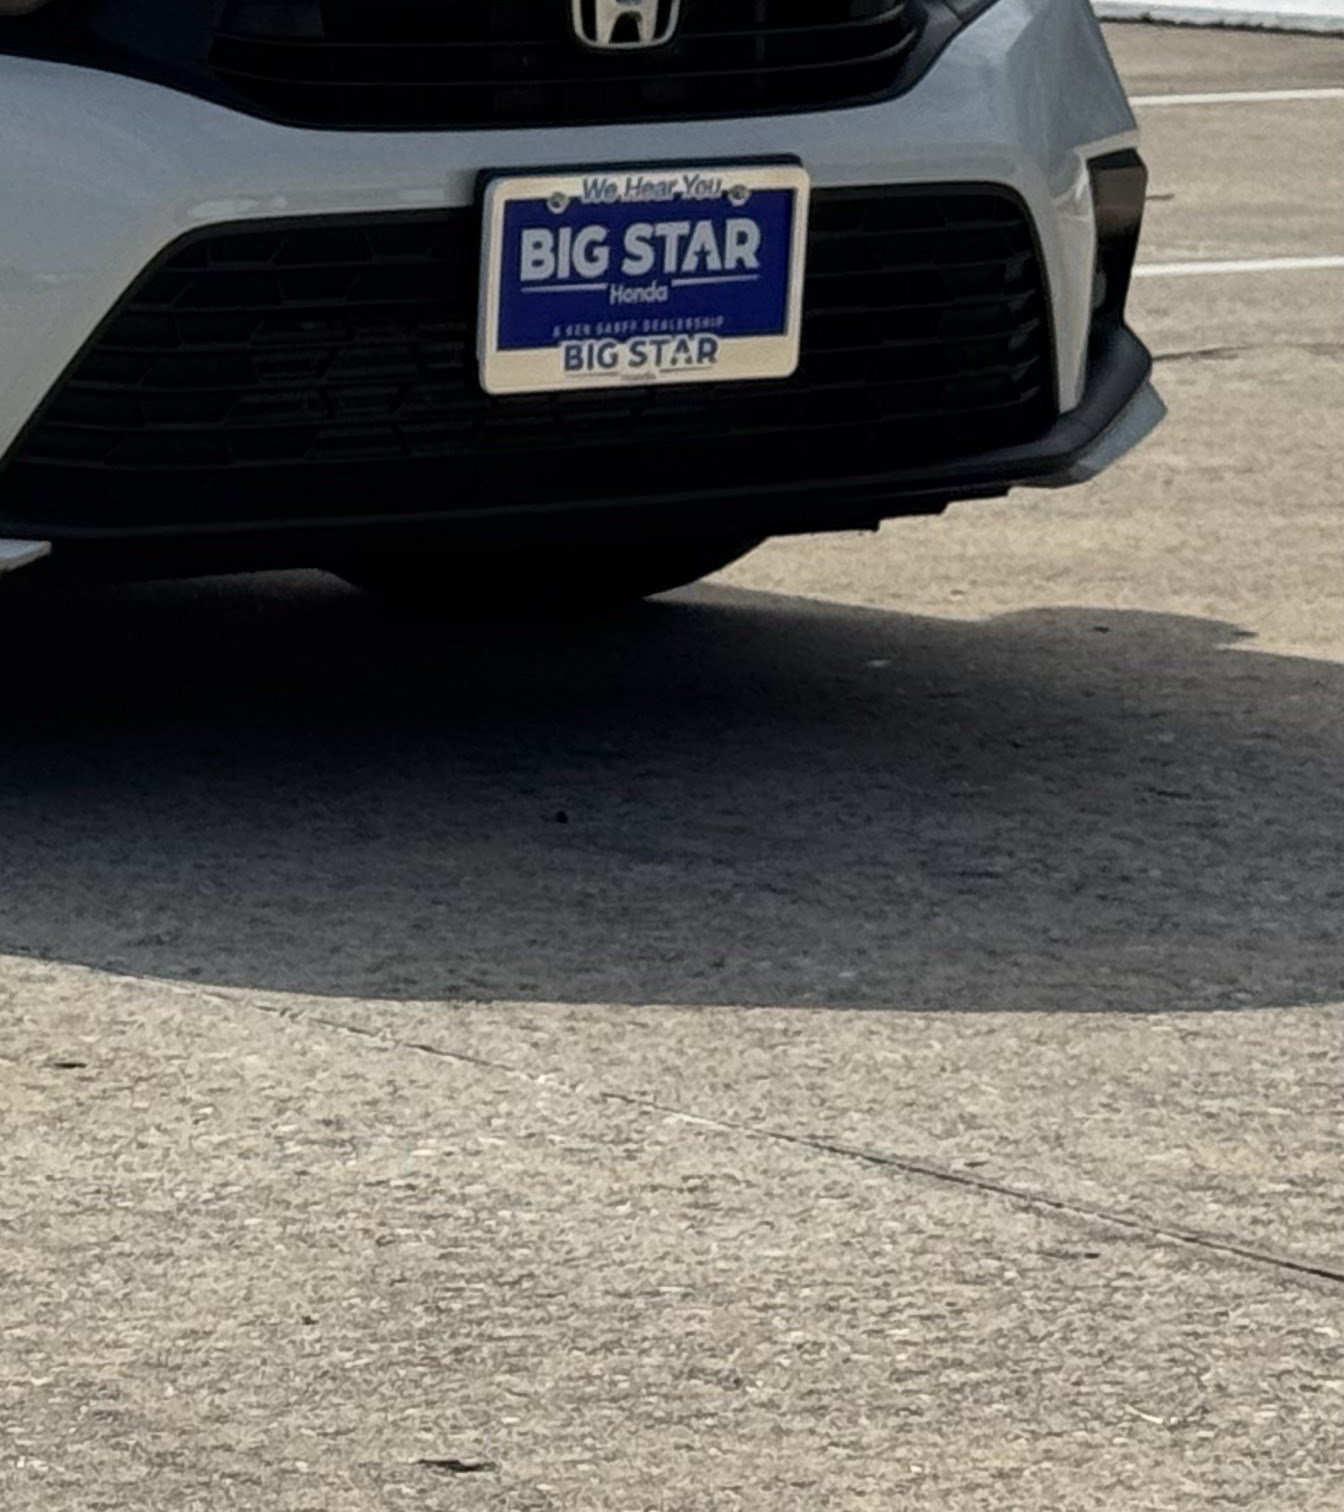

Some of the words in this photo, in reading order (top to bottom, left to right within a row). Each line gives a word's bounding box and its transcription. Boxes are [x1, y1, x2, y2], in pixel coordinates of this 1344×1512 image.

[582, 177, 618, 201] We
[623, 176, 677, 198] Hear
[682, 173, 723, 195] You
[520, 224, 610, 282] BIG
[621, 218, 760, 276] STAR
[609, 280, 668, 305] Honda
[564, 340, 619, 372] BIG
[628, 337, 719, 369] STAR
